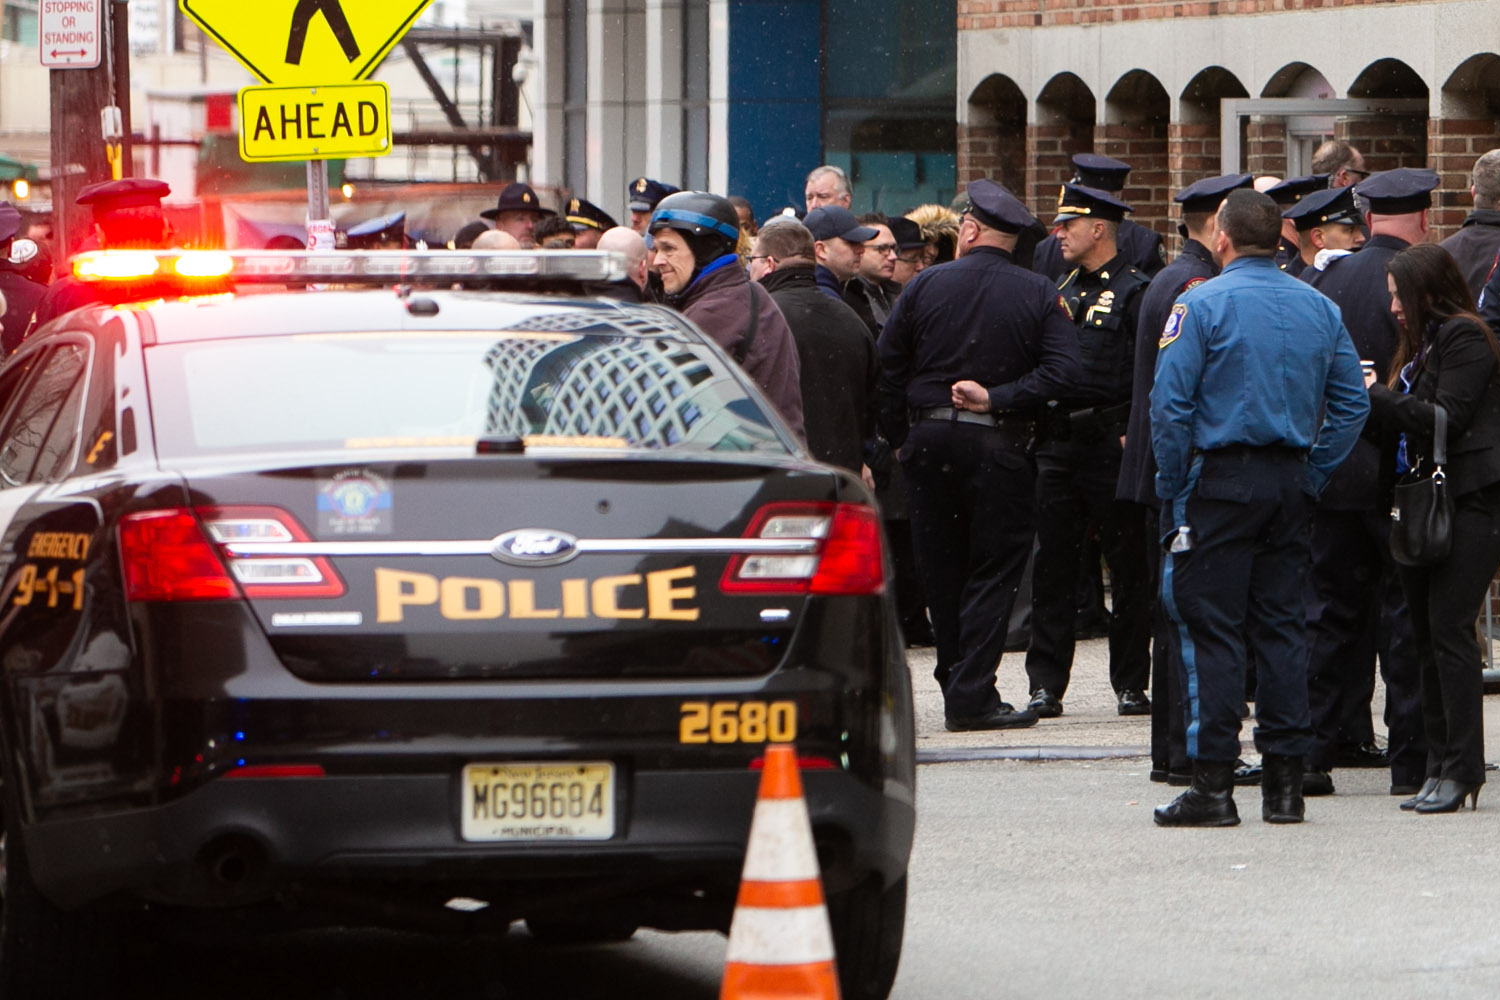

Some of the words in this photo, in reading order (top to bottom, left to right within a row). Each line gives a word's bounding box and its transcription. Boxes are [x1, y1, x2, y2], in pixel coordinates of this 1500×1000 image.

[45, 1, 94, 14] STOPPING
[62, 15, 76, 28] OR
[45, 31, 94, 45] STANDING
[253, 101, 379, 141] AHEAD
[27, 532, 94, 561] EMERGENCY
[510, 534, 561, 556] Ford
[13, 565, 86, 610] 9-1-1
[374, 566, 700, 623] POLICE
[679, 701, 797, 744] 2680
[472, 782, 604, 820] MG96684
[501, 826, 575, 837] MUNICIPAL
